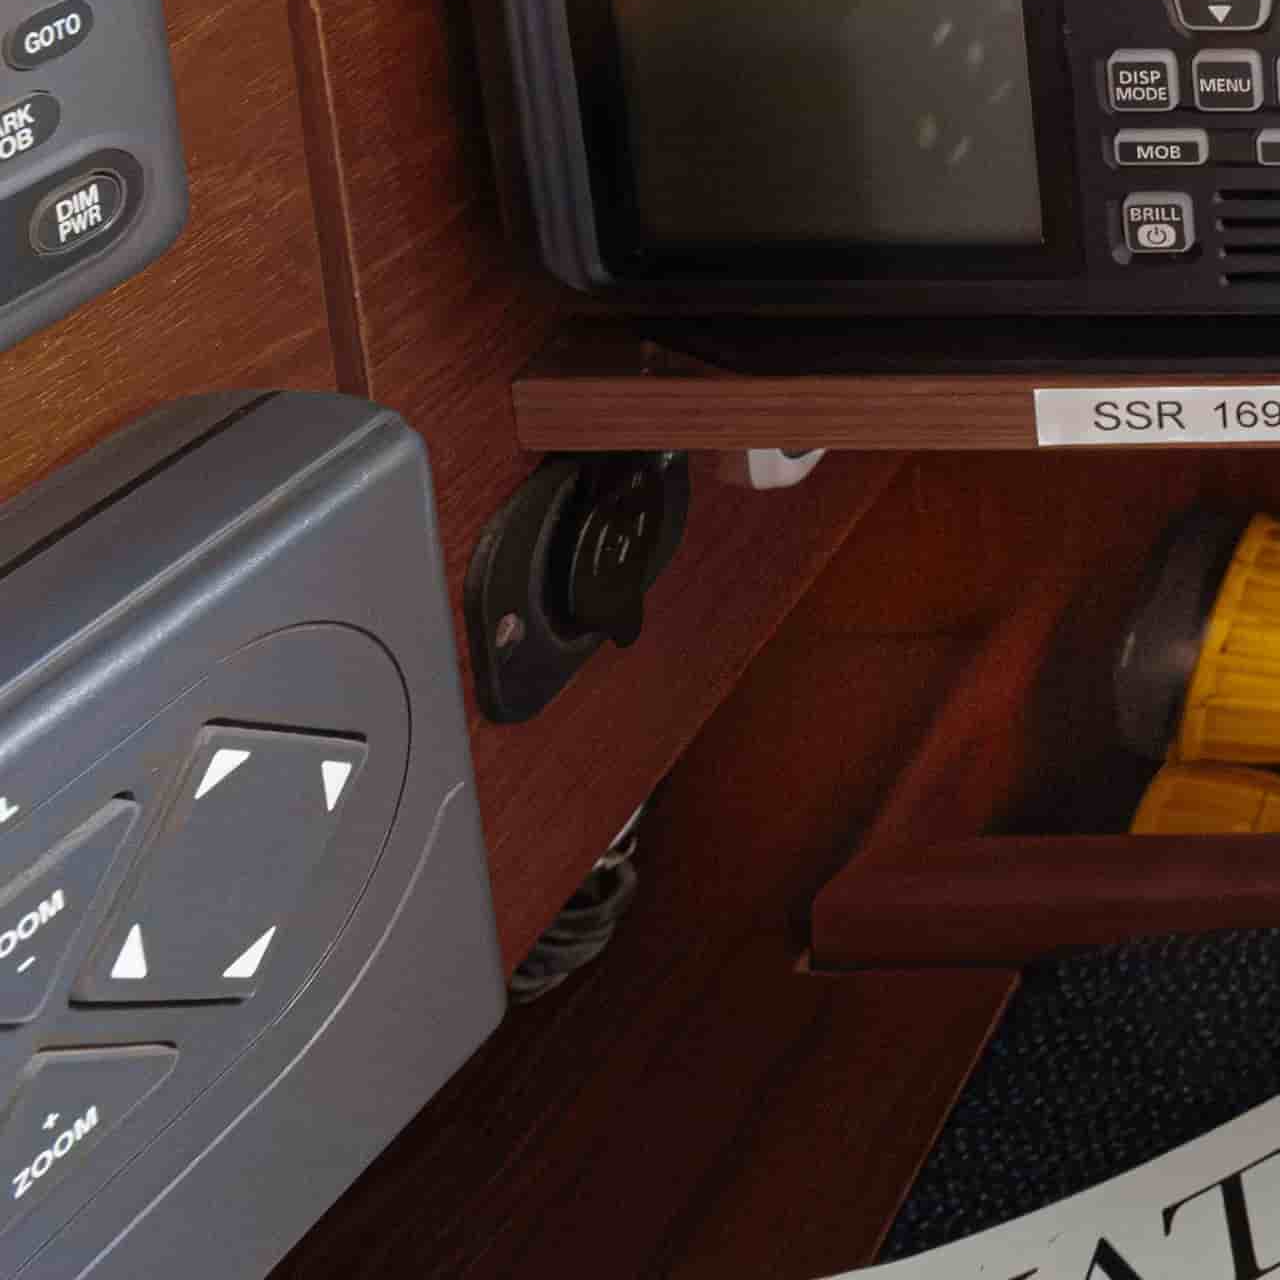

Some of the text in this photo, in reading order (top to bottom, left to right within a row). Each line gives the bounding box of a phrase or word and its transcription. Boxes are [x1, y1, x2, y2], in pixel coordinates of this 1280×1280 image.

[24, 13, 81, 54] GOTO
[1120, 70, 1161, 85] DISP
[1199, 78, 1252, 94] MENU
[1115, 86, 1168, 102] MODE
[0, 104, 35, 137] RK
[0, 128, 35, 159] OB
[1136, 145, 1182, 160] MOB
[56, 184, 99, 222] DIM
[1130, 207, 1182, 222] BRILL
[58, 205, 103, 243] PWR
[1093, 400, 1186, 431] SSR
[0, 889, 65, 959] OOM
[11, 1105, 99, 1200] ZOOM
